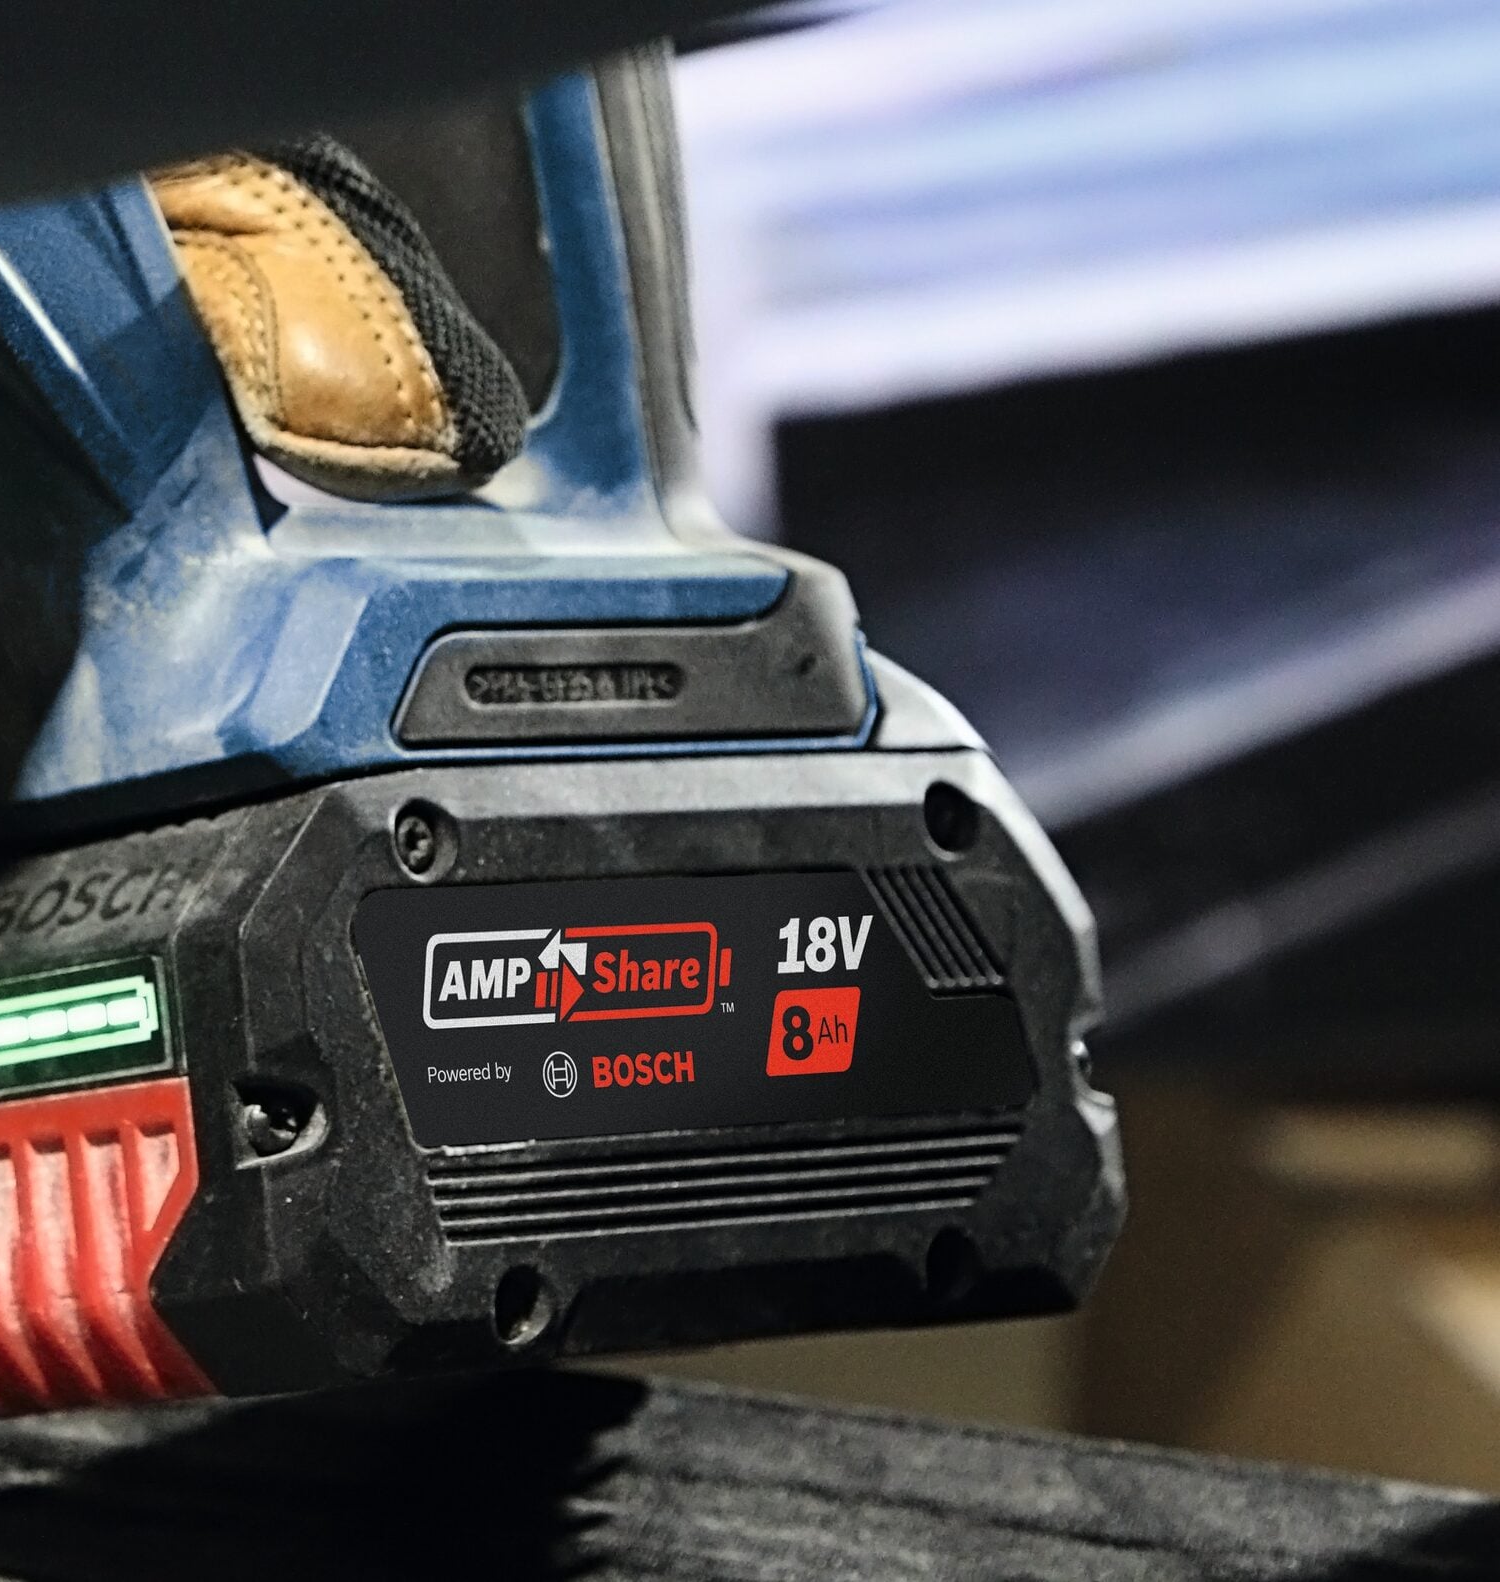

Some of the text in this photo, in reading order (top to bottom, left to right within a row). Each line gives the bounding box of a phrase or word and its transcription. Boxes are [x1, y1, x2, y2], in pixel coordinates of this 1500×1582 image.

[777, 915, 874, 974] 18V
[438, 957, 532, 1002] AMP
[592, 949, 700, 993] Share
[427, 1050, 696, 1089] Powered by BOSCH
